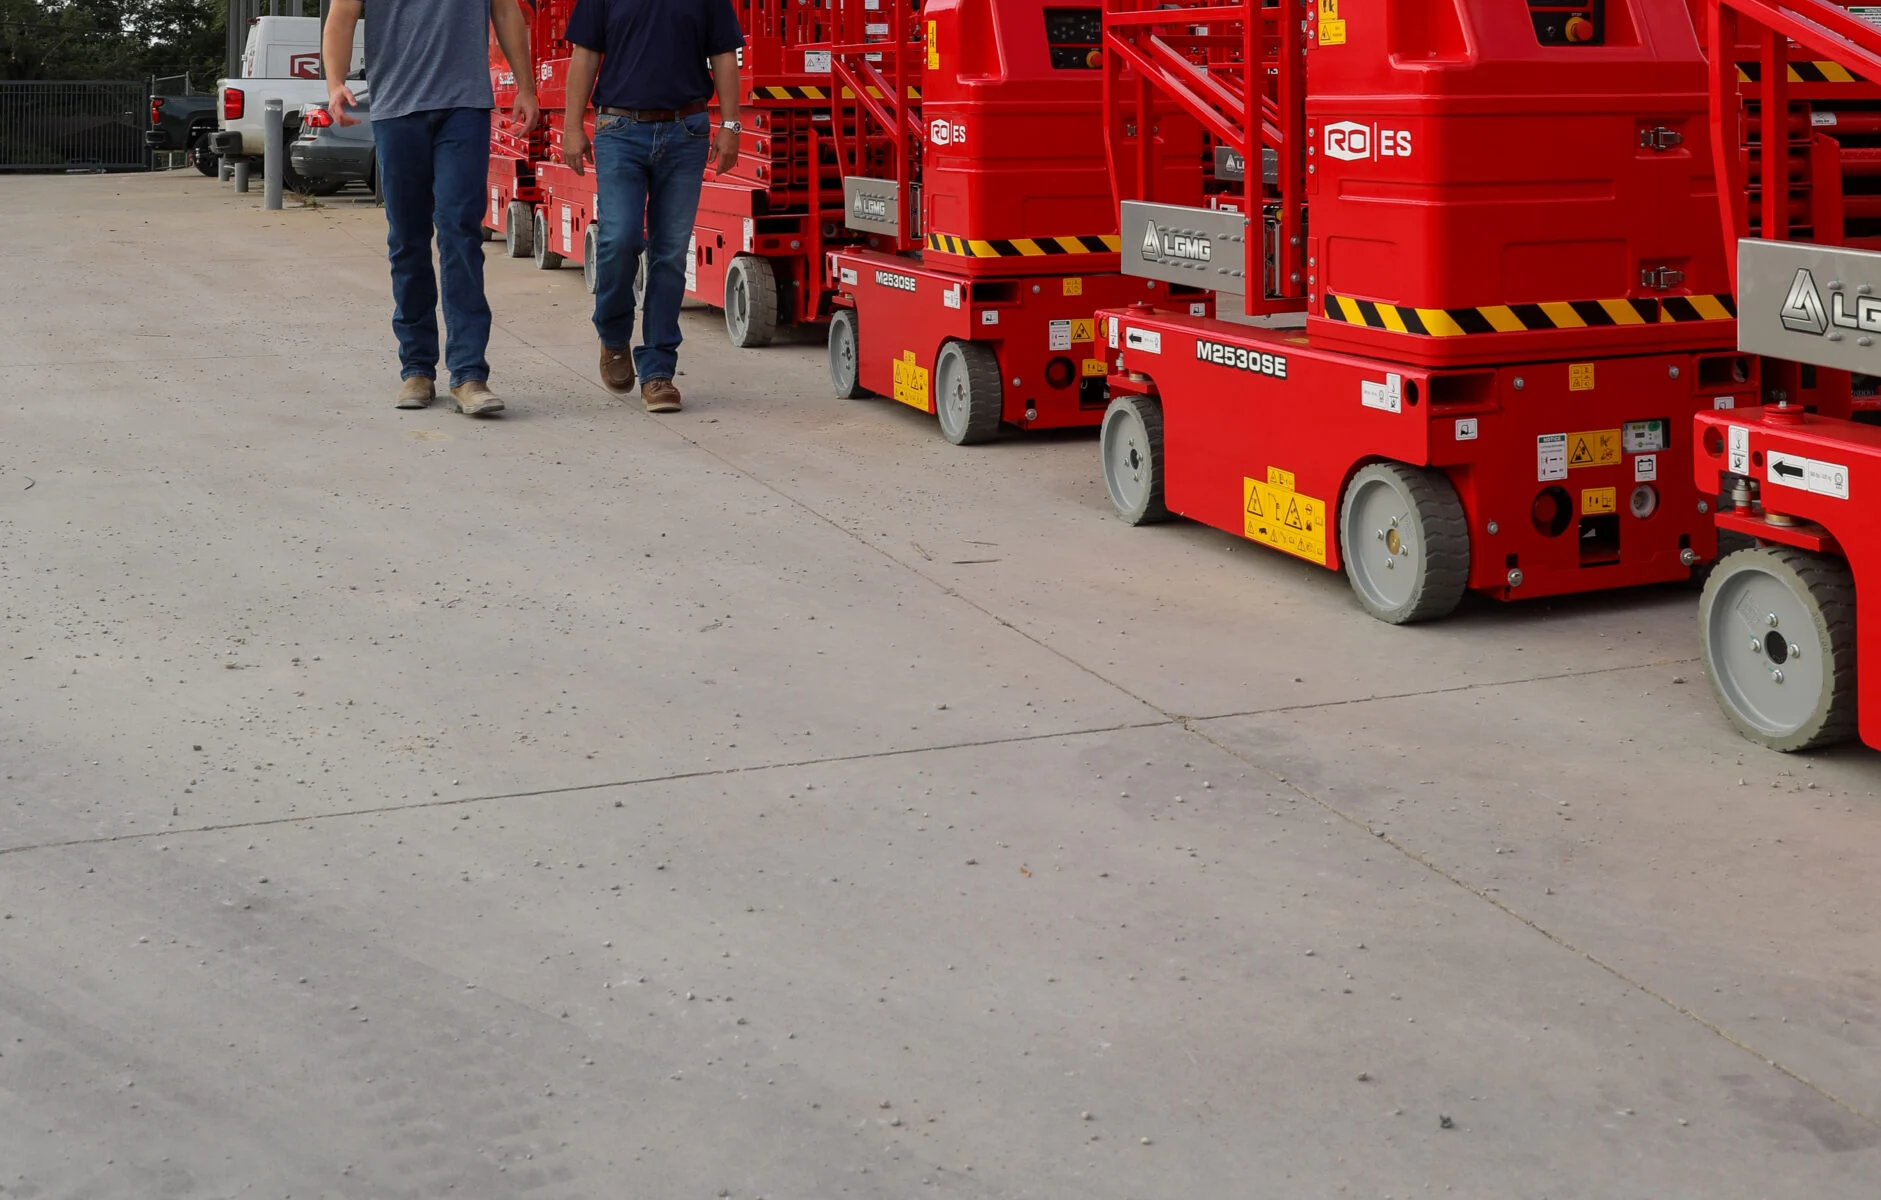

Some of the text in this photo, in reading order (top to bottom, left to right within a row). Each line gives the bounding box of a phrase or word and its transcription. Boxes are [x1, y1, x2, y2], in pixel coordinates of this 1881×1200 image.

[932, 123, 966, 143] RO ES
[1326, 127, 1412, 157] RO ES
[863, 199, 885, 216] LGMG
[1164, 235, 1211, 261] LGMG
[876, 270, 916, 292] M2530SE
[1196, 339, 1287, 379] M2530SE
